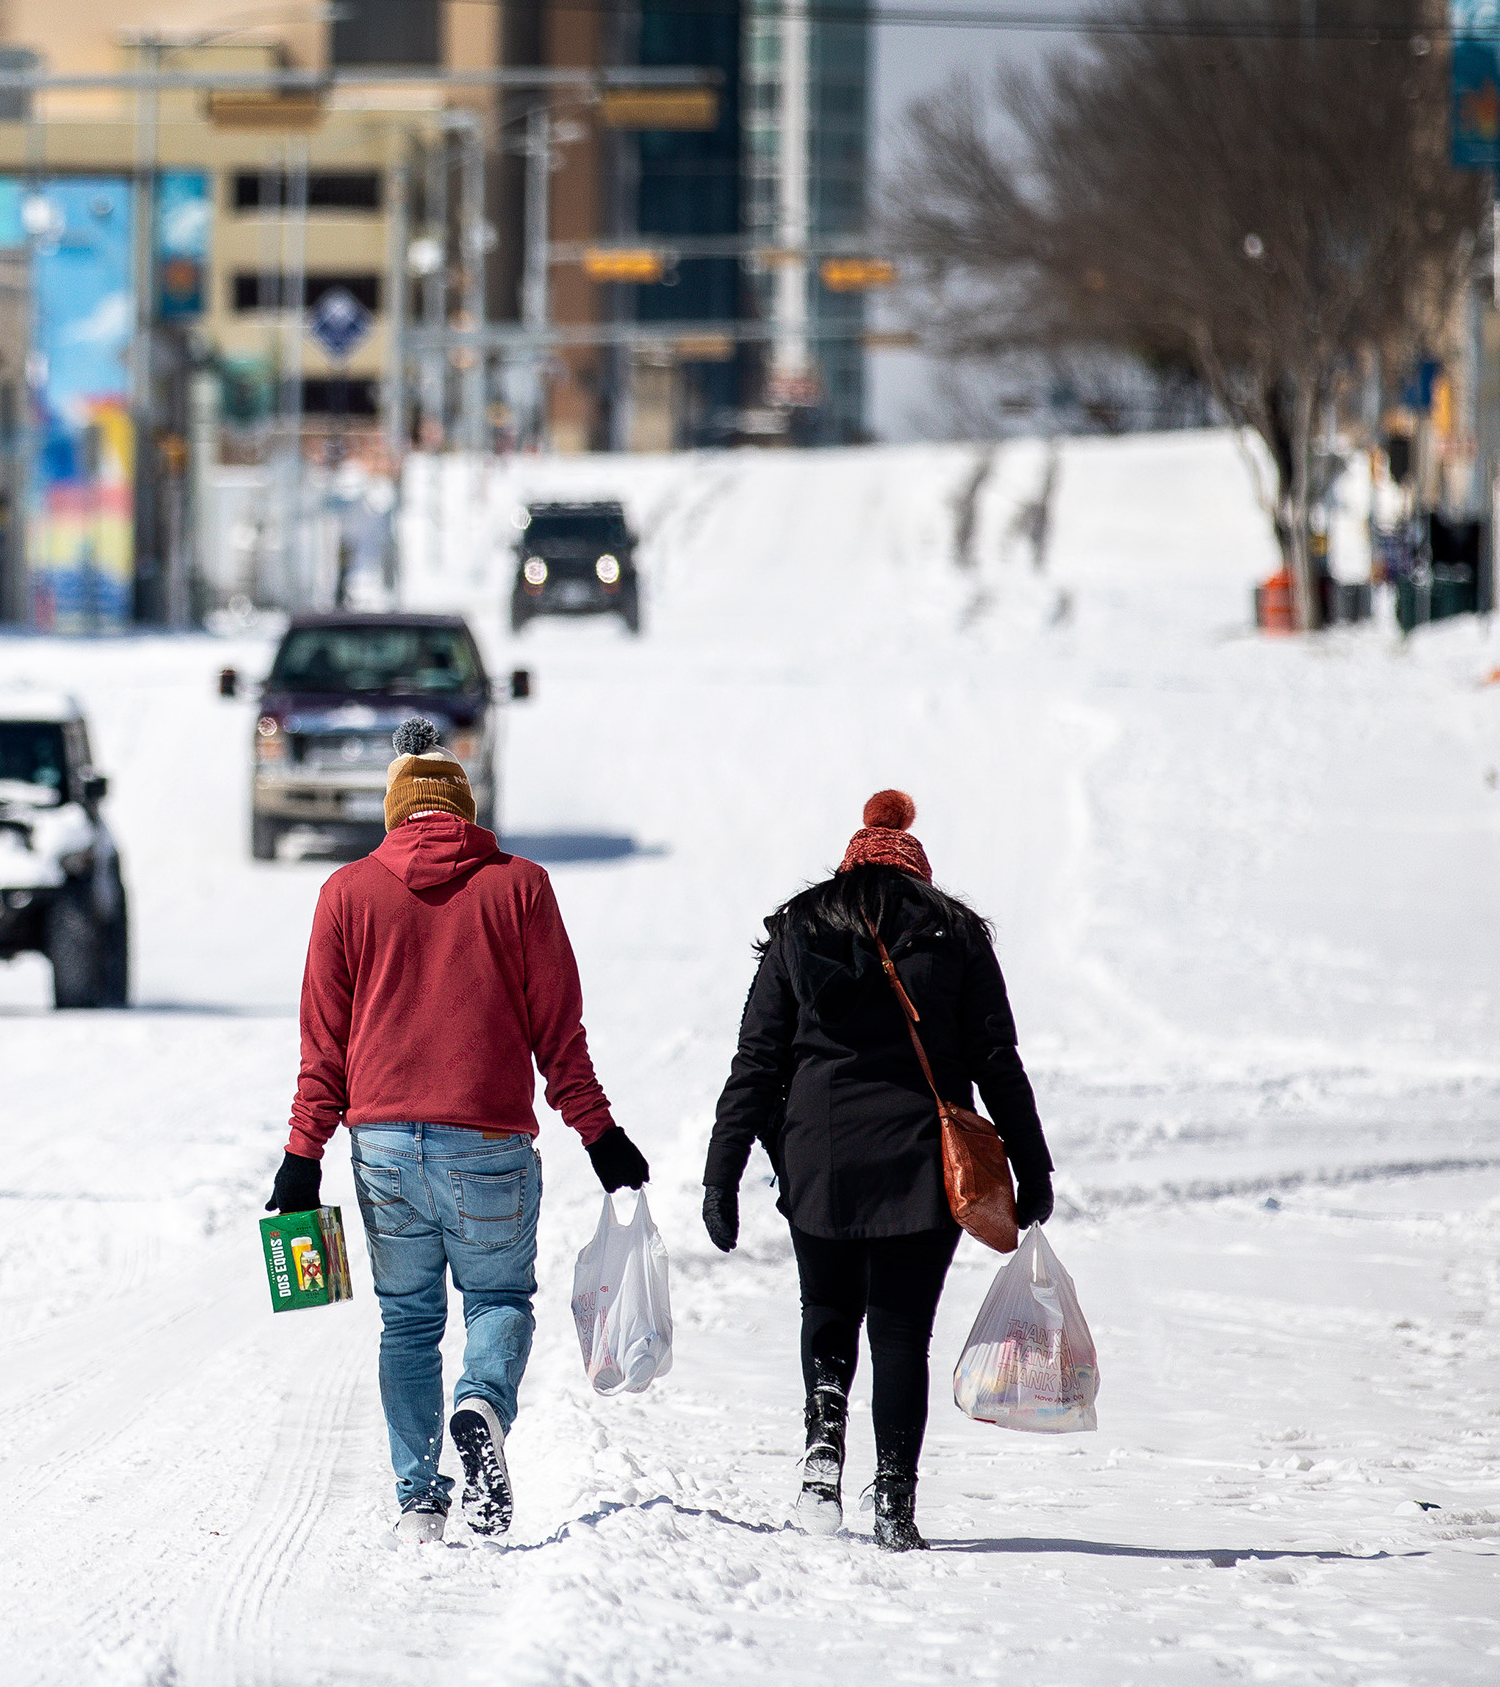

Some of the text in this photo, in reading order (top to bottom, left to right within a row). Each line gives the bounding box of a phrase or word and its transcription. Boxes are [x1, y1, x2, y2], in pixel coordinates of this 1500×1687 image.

[270, 1238, 288, 1272] EQUIS
[276, 1274, 292, 1298] DOS
[996, 1362, 1057, 1392] THANK
